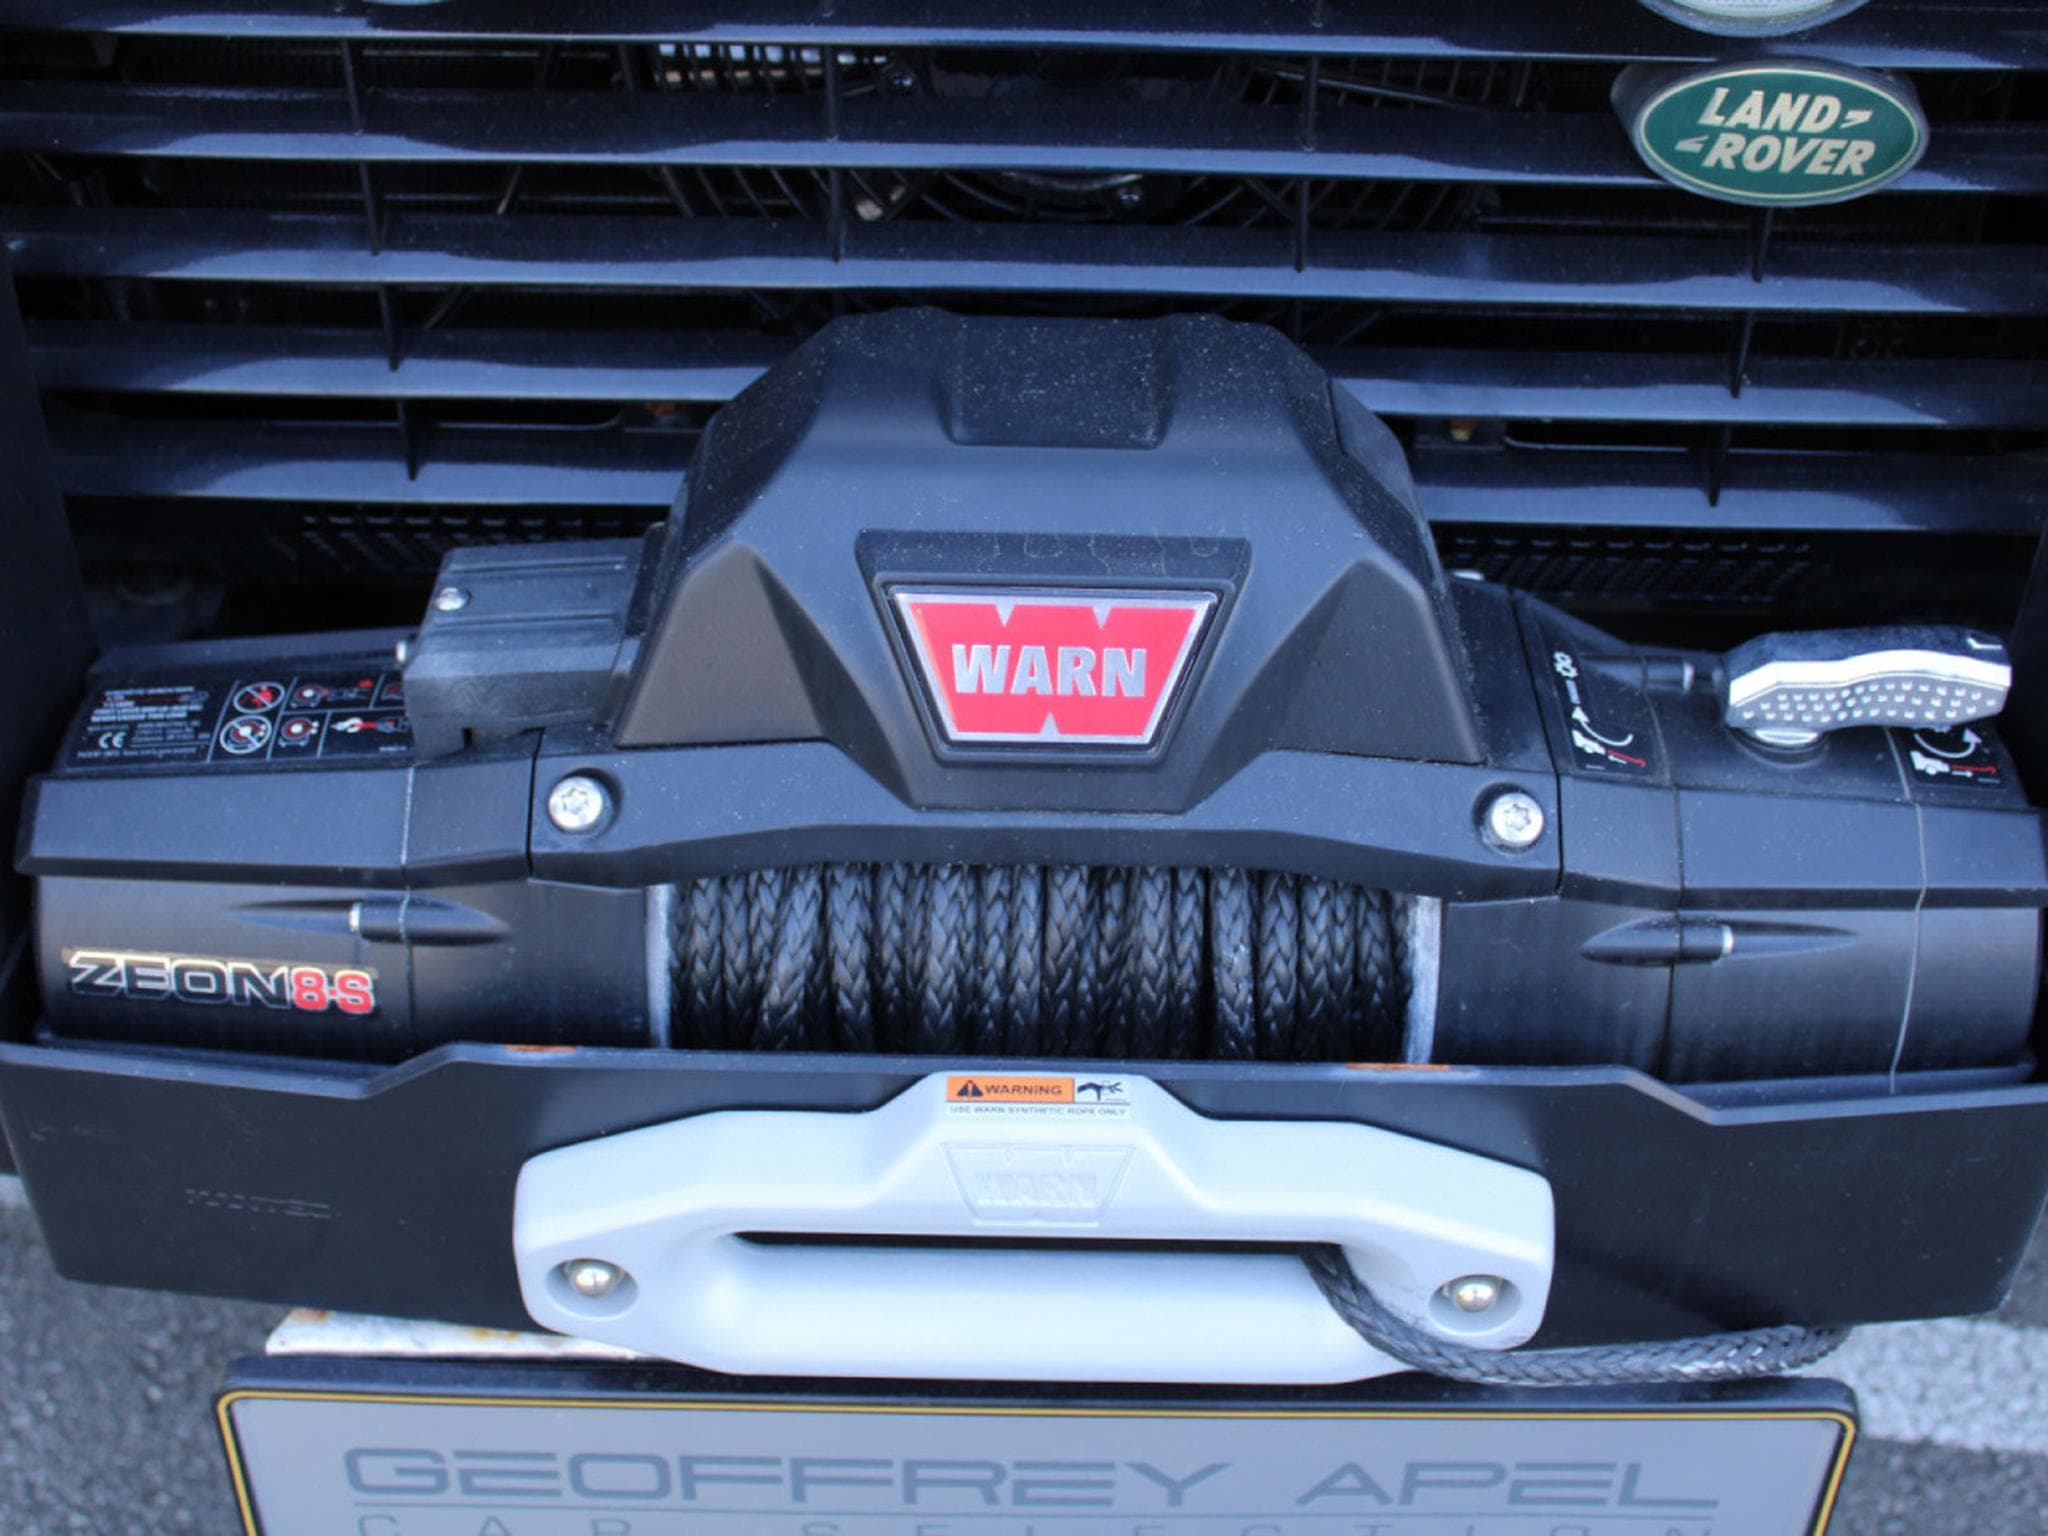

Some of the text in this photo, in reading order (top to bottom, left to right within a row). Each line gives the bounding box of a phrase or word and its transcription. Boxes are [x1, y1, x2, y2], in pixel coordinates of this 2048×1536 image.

[1697, 87, 1842, 134] LAND
[1702, 133, 1876, 176] ROVER
[952, 644, 1147, 697] WARN
[950, 1106, 1126, 1117] USE WARN SYNTHETIC ROPE ONLY
[985, 1084, 1063, 1096] WARNING
[343, 1447, 1720, 1509] GEOFFREY APEL
